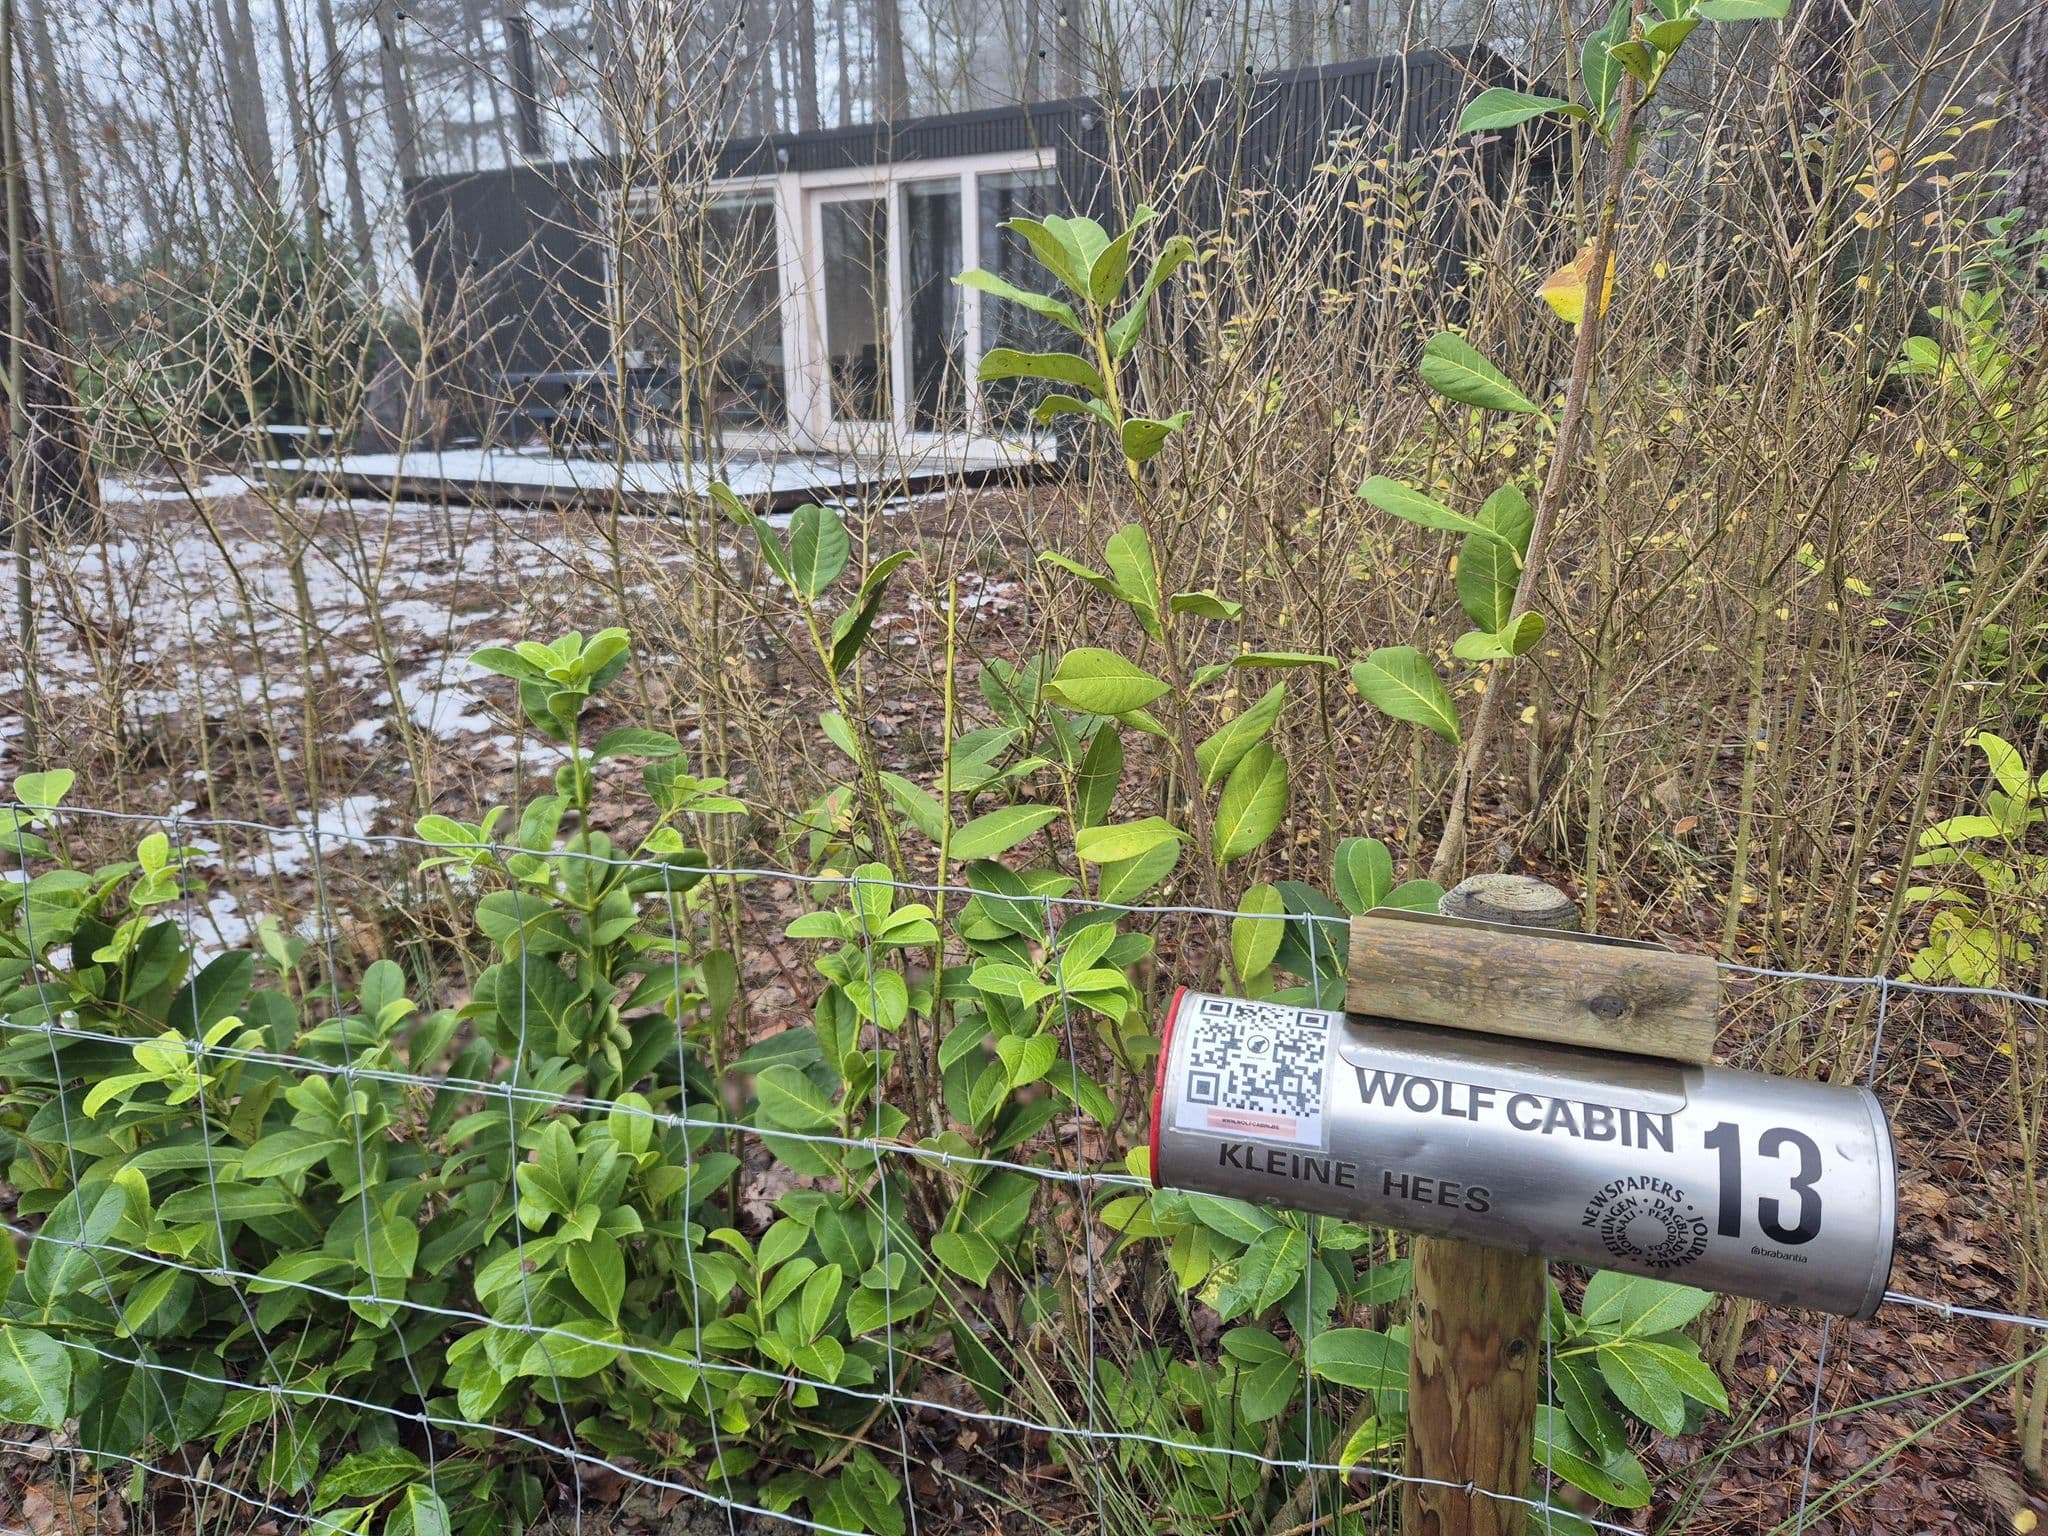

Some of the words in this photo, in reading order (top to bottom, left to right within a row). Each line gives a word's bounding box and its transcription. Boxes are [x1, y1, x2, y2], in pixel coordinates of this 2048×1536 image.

[1355, 1067, 1497, 1122] WOLF
[1506, 1093, 1675, 1153] CABIN
[1218, 1142, 1357, 1189] KLEINE
[1382, 1171, 1491, 1213] HEES
[1582, 1175, 1685, 1228] NEWSPAPERS
[1704, 1121, 1823, 1246] 13
[1601, 1196, 1638, 1258] ZEITUNGEN
[1615, 1210, 1642, 1255] GIORNALI
[1645, 1215, 1709, 1269] JOURNAUX
[1653, 1198, 1689, 1259] DAGBLADEN
